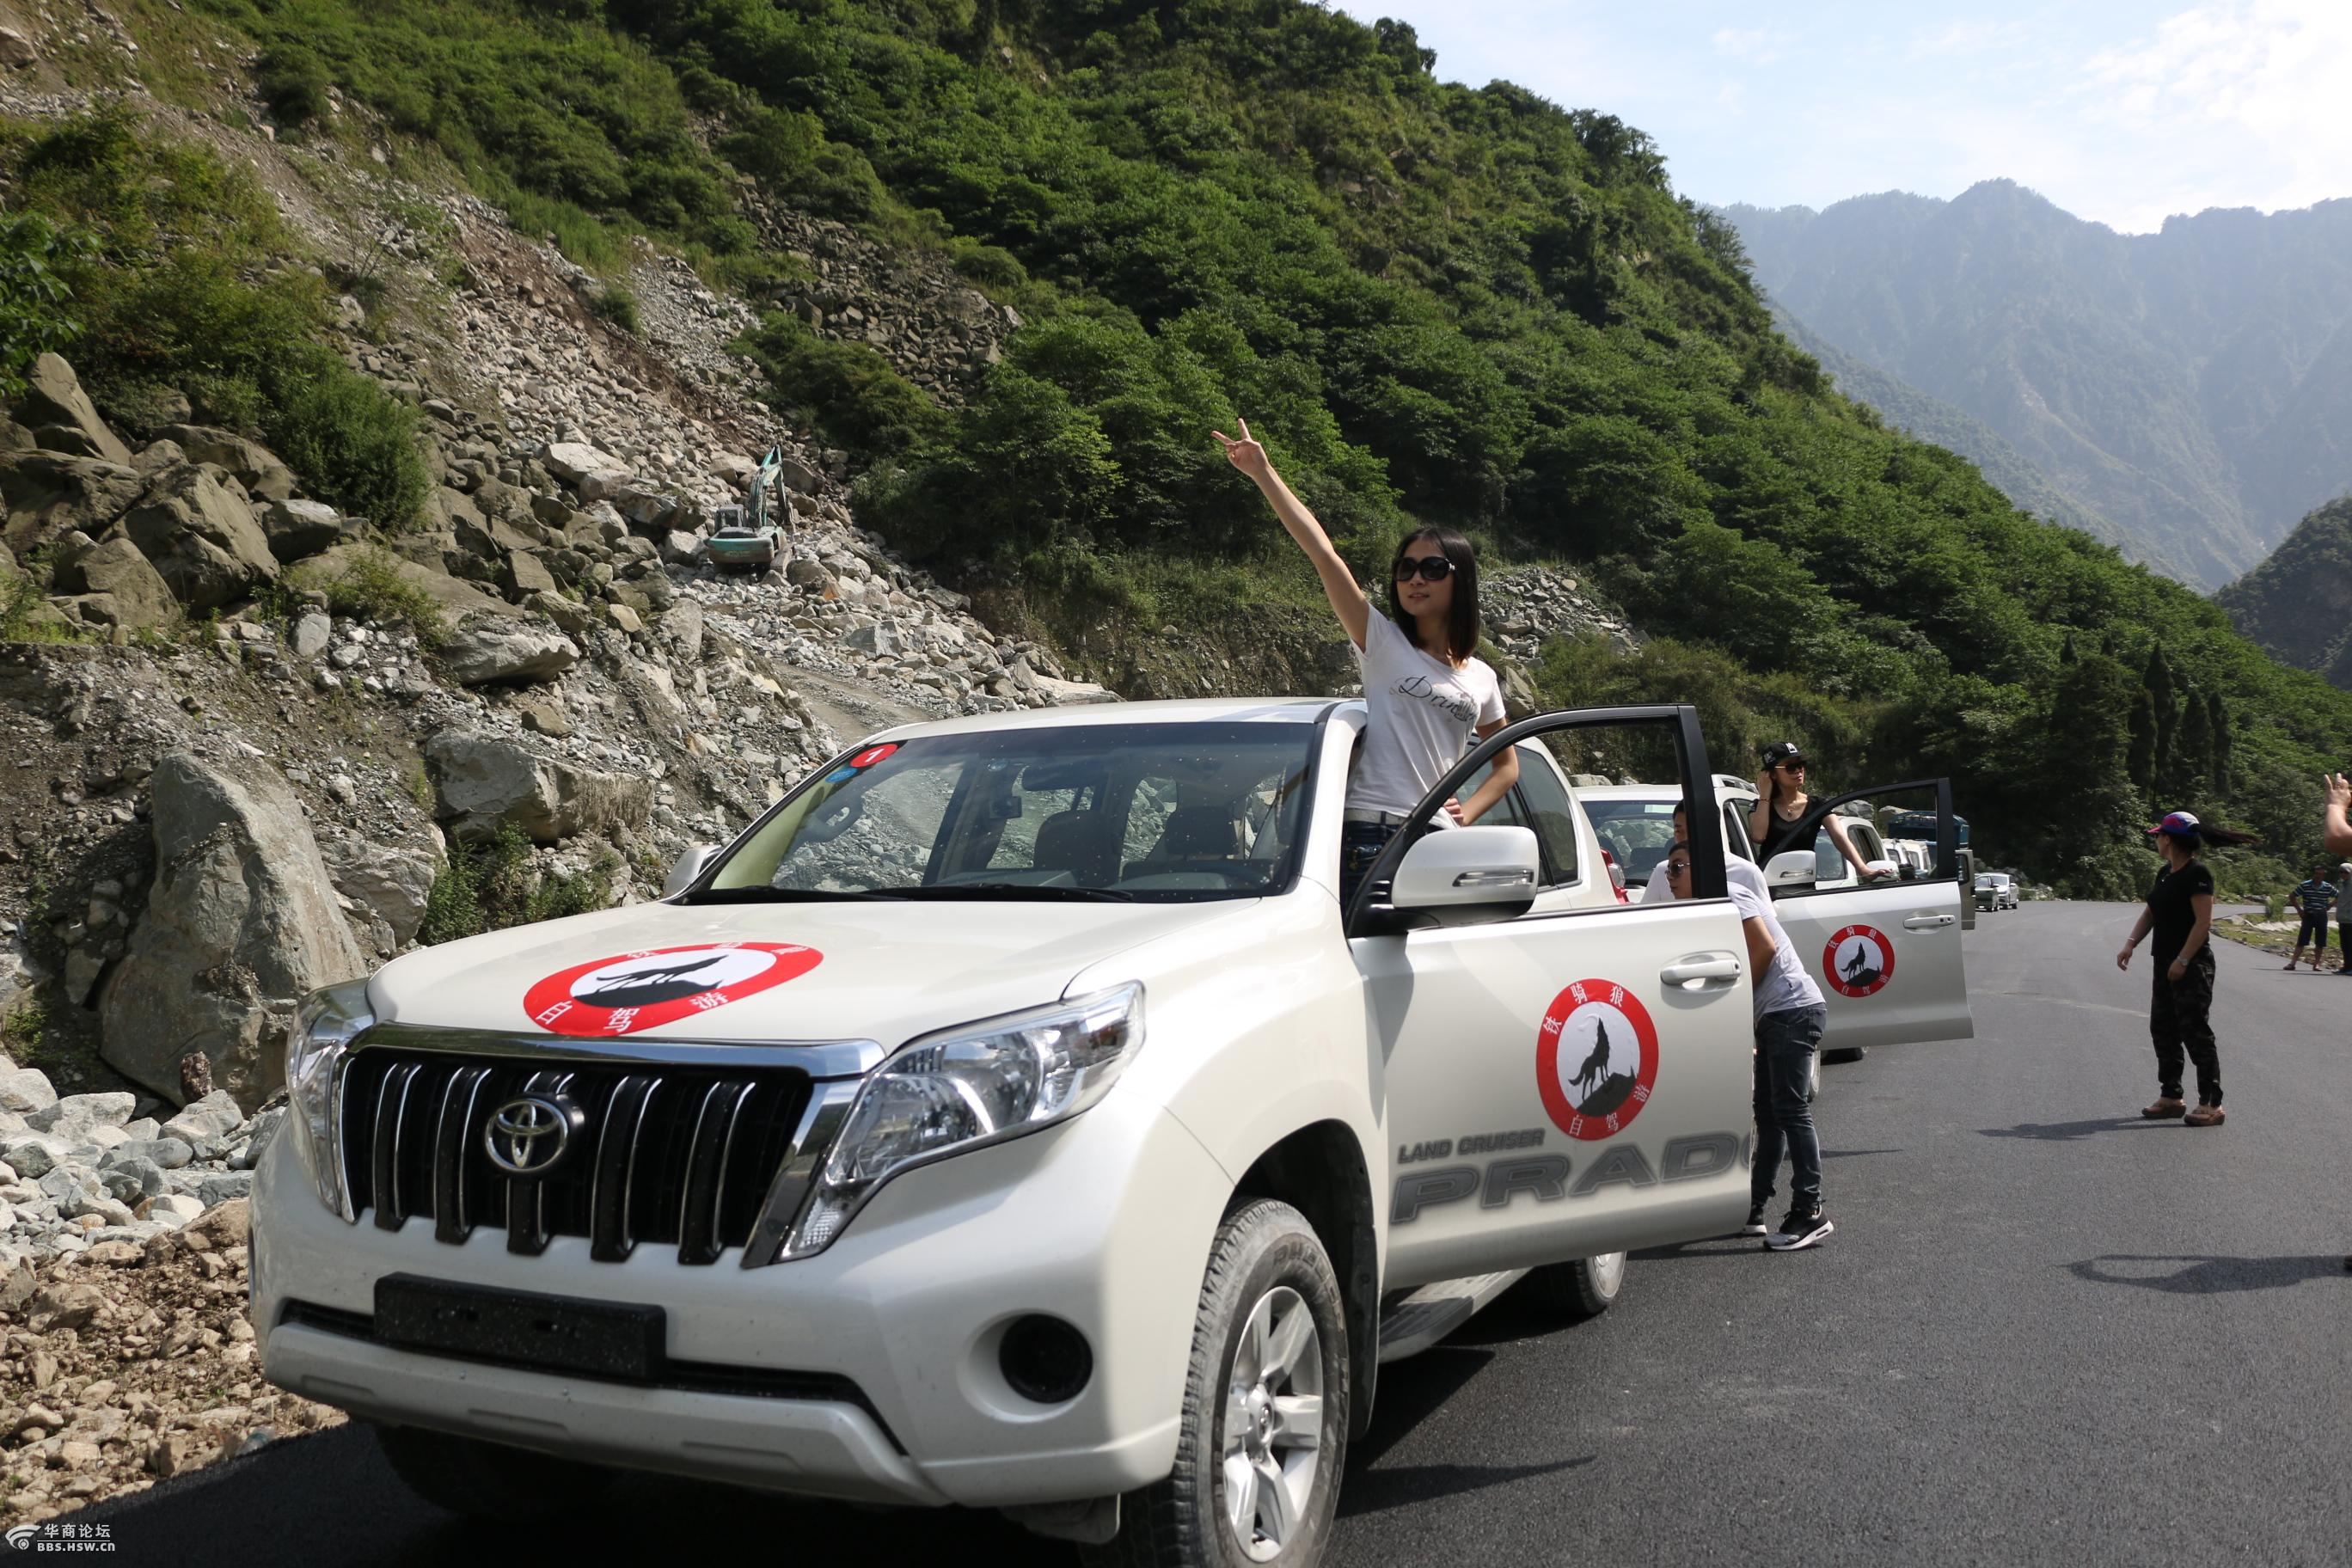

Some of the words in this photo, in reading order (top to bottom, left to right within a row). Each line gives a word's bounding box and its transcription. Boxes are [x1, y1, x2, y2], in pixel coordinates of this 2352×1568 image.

[865, 748, 885, 763] 1
[536, 991, 730, 1032] 自驾游
[1397, 1139, 1453, 1164] LAND
[1457, 1127, 1546, 1155] CRUISER
[1388, 1130, 1750, 1225] PRAD
